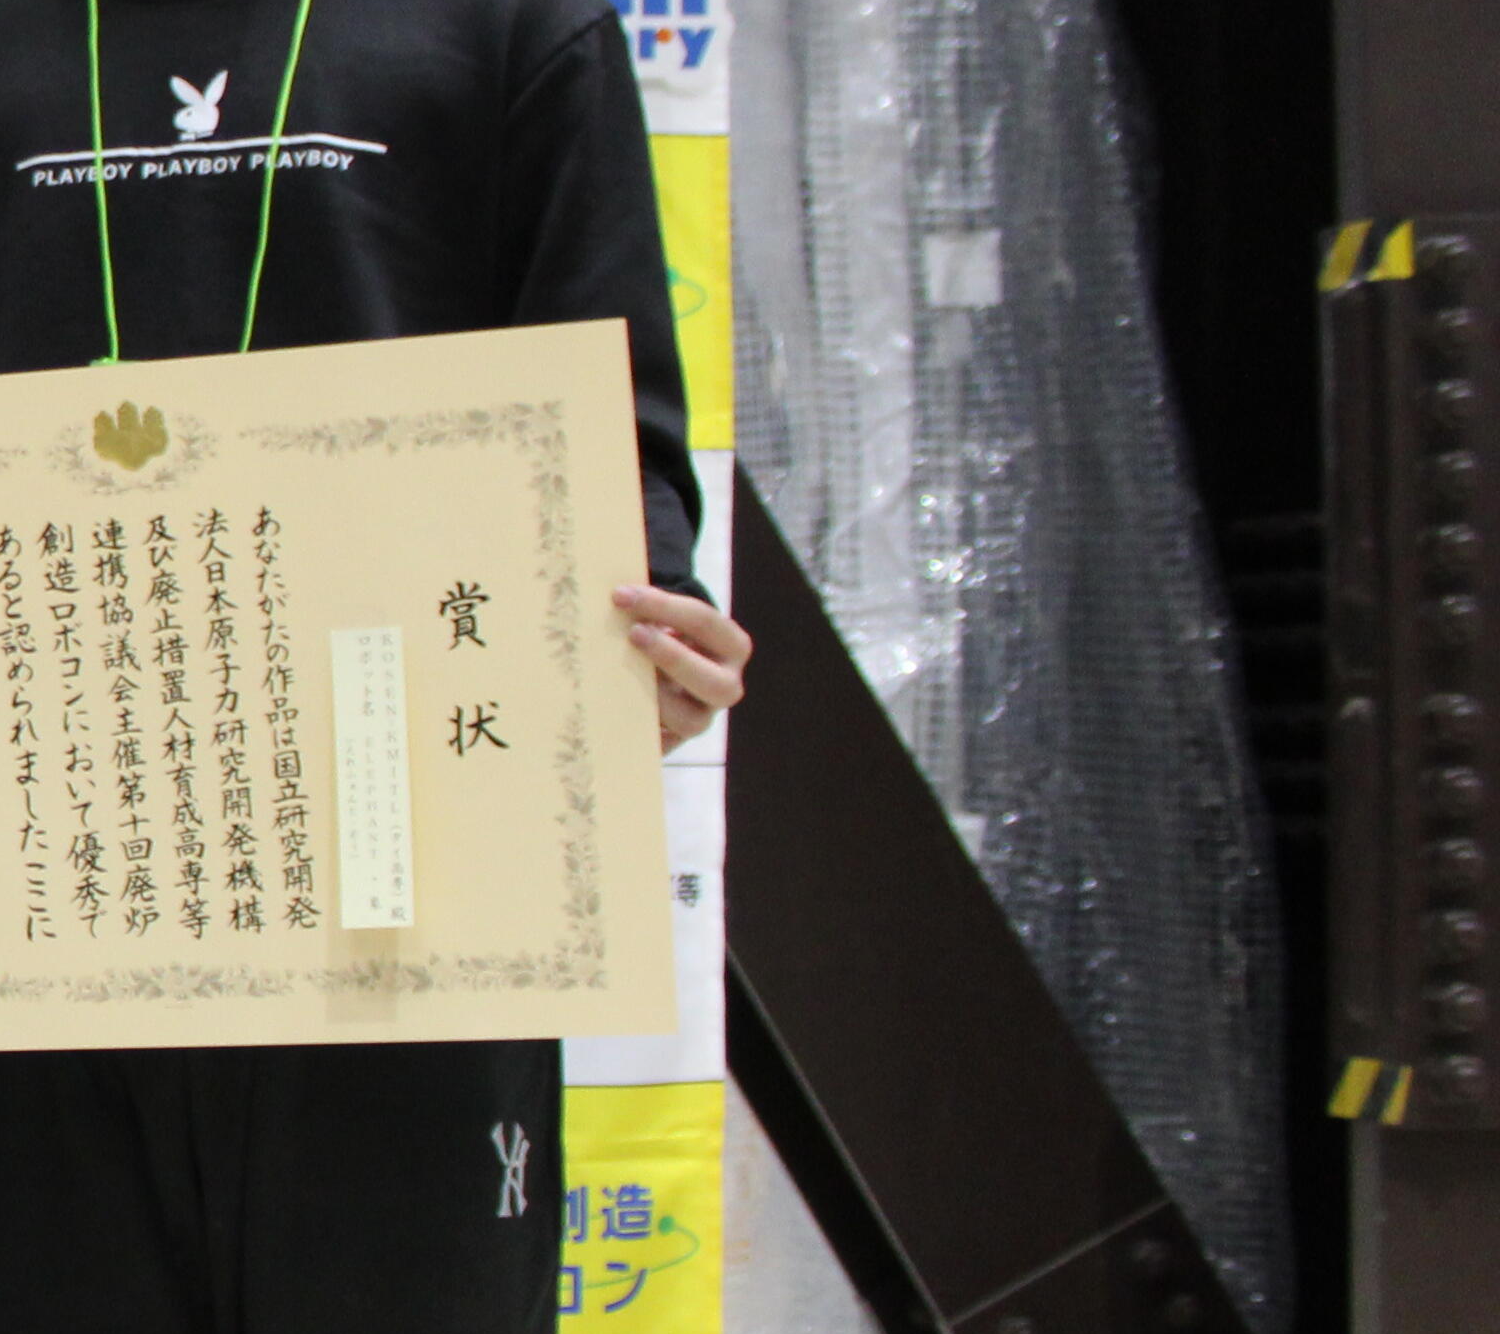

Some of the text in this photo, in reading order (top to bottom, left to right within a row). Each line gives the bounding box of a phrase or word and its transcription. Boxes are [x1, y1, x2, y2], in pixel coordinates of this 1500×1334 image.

[141, 155, 242, 180] PLAYBOY
[36, 521, 111, 939] 創造ロボコンにおいて優秀で
[92, 518, 161, 938] 連携協議会主催第十回廃炉
[143, 514, 212, 940] 及び廃止措置人材育成高専等
[193, 507, 267, 935] 法人日本原子力研究開発機構
[252, 505, 321, 930] あなたがたの作品は国立研究開発
[437, 580, 511, 758] 賞状
